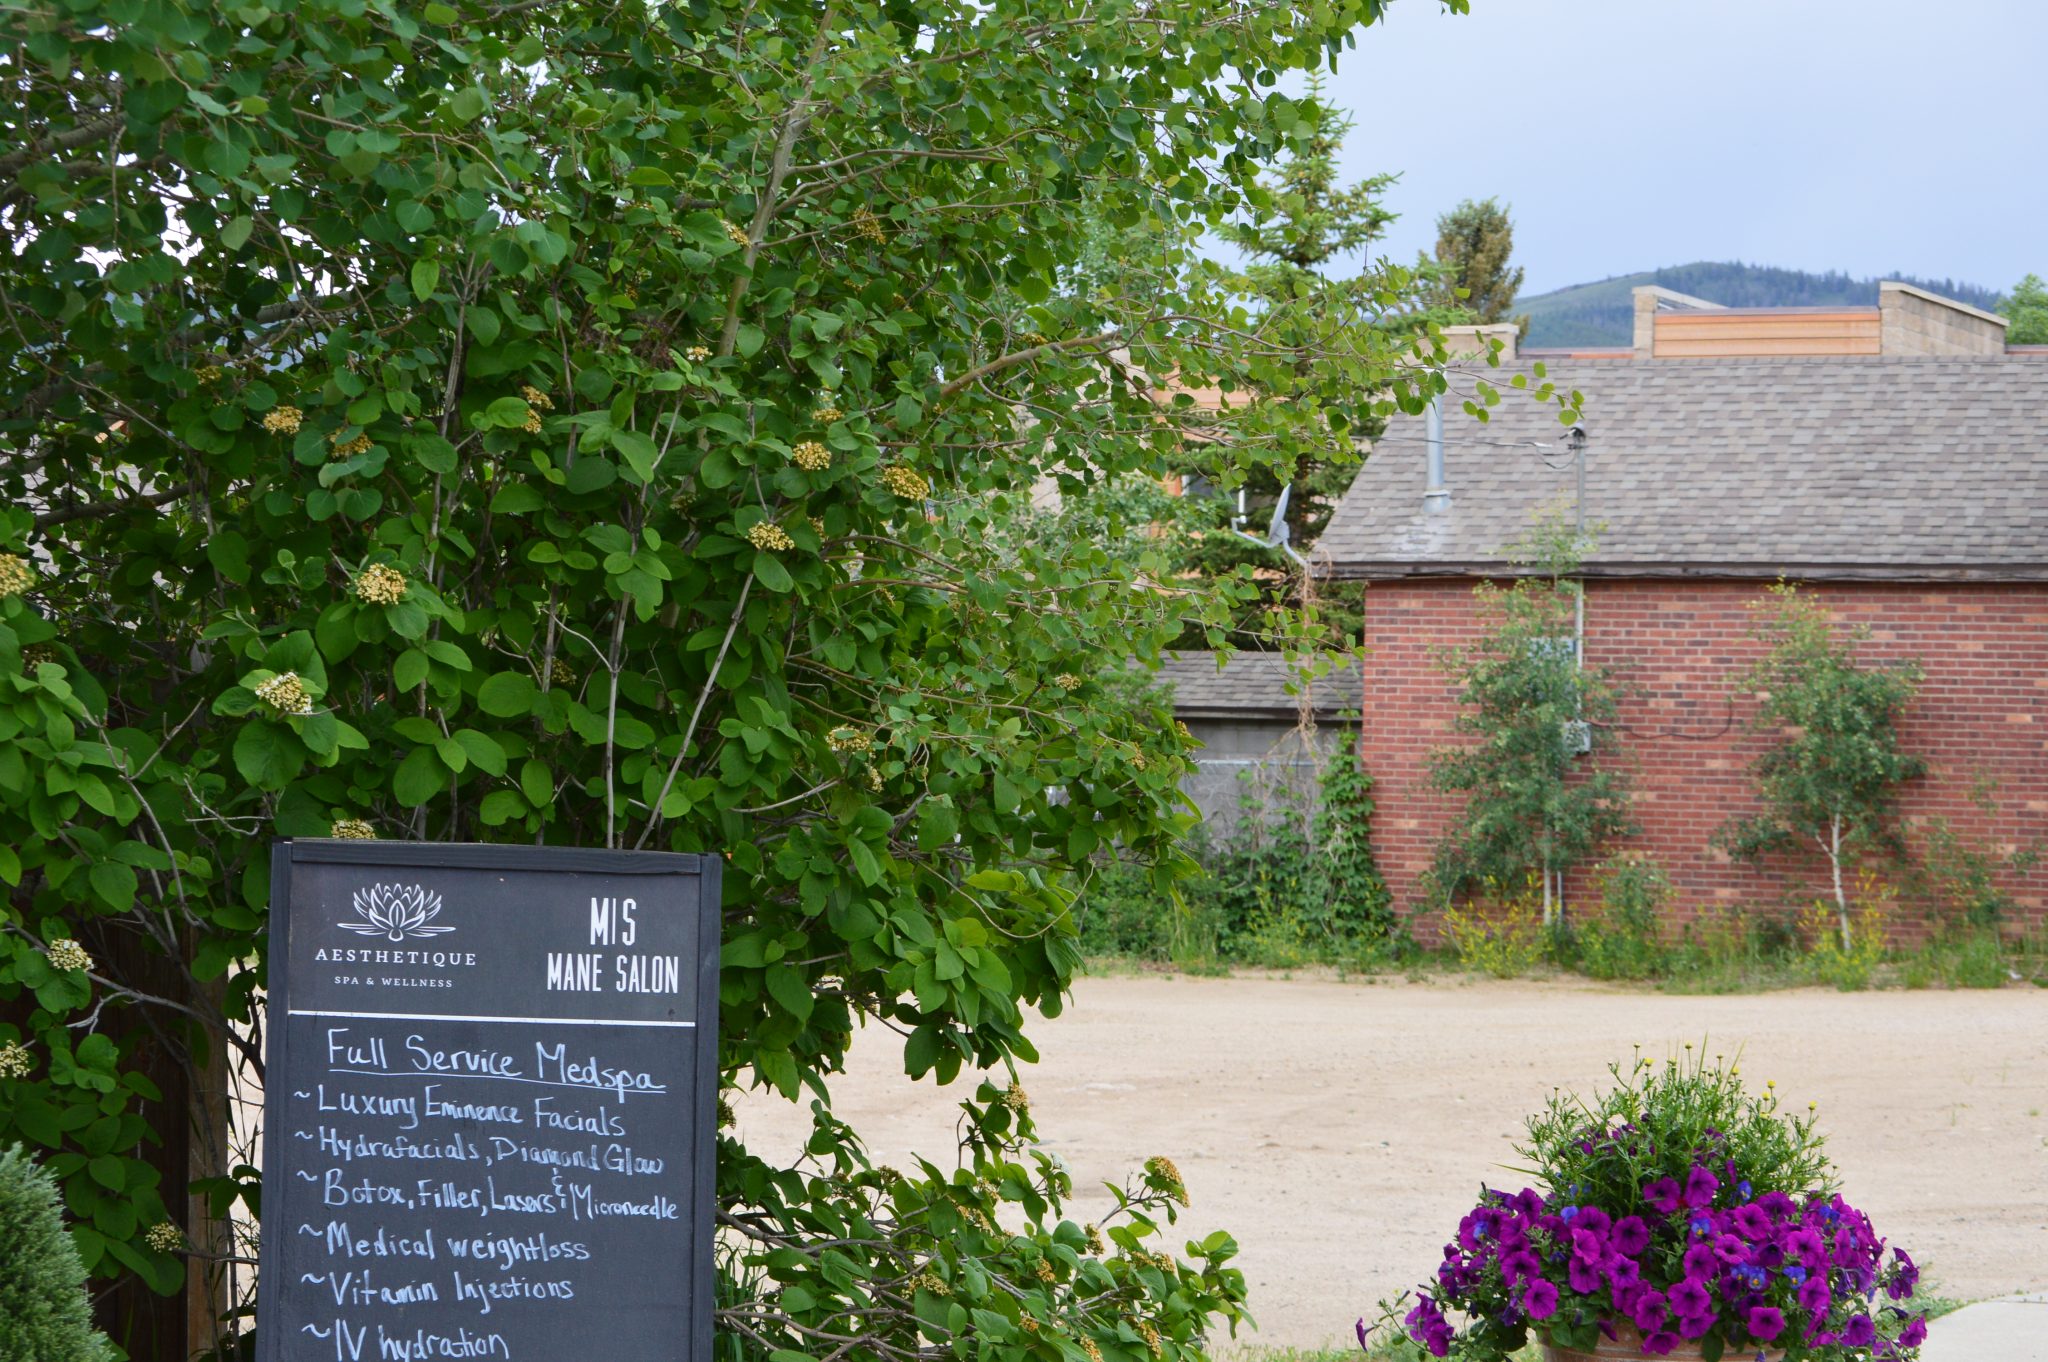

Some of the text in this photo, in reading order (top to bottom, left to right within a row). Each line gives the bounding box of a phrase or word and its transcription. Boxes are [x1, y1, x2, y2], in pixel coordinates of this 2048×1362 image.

[590, 897, 637, 947] MIS
[315, 948, 477, 968] AESTHETIQUE
[547, 952, 679, 994] MANE SALON
[334, 976, 453, 988] SPA & WELLNESS
[328, 1028, 667, 1104] Full Service Medspa
[318, 1084, 626, 1136] Luxury Eminence Facials
[489, 1136, 601, 1171] Diamond
[488, 1175, 557, 1213] Lasers
[569, 1182, 679, 1220] Microneedle
[326, 1220, 591, 1271] Medical weightloss
[329, 1269, 575, 1314] Vitamin Injections
[378, 1324, 510, 1362] hydration
